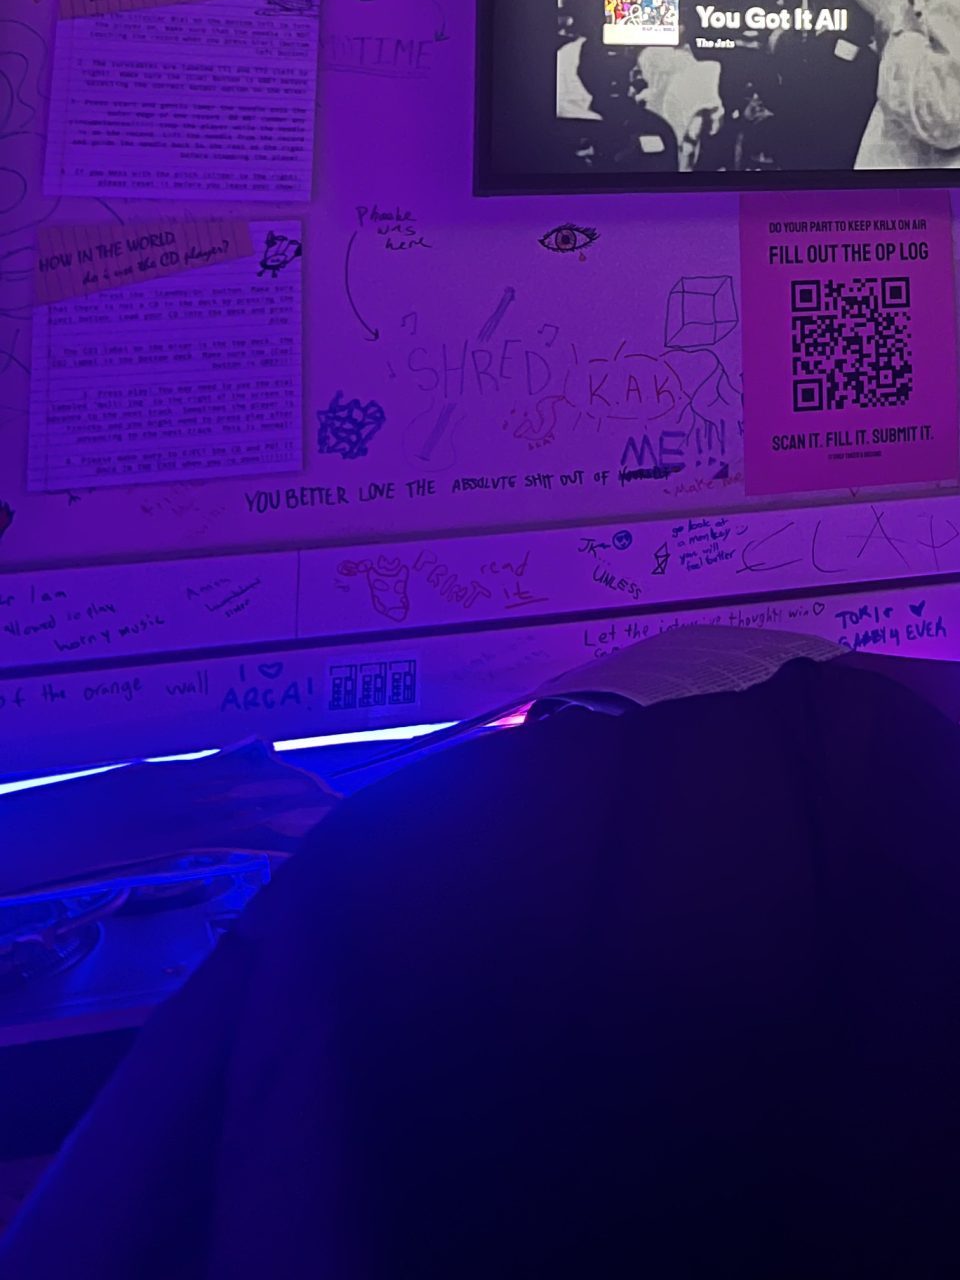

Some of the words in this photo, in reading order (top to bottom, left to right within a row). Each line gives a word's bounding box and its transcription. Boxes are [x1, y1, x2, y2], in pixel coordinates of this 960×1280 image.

[696, 6, 740, 29] You
[745, 7, 791, 31] Got
[794, 8, 812, 31] It
[815, 8, 848, 31] All
[696, 38, 714, 48] The
[769, 222, 782, 233] DO
[784, 221, 808, 233] YOUR
[809, 221, 834, 233] PART
[835, 220, 846, 232] TO
[849, 220, 871, 231] KEEP
[873, 219, 897, 231] KRLX
[898, 219, 910, 230] ON
[912, 219, 927, 230] AIR
[39, 254, 72, 272] HOW
[78, 248, 93, 264] IN
[96, 241, 123, 259] THE
[126, 232, 176, 253] WORLD
[159, 251, 179, 267] CD
[769, 245, 803, 264] FILL
[807, 244, 839, 263] OUT
[841, 243, 872, 262] THE
[875, 242, 896, 261] OP
[900, 241, 929, 261] LOG
[407, 339, 551, 401] SHRED
[772, 433, 806, 451] SCAN
[809, 432, 823, 448] IT.
[826, 431, 853, 448] FILL
[856, 429, 870, 445] IT.
[872, 426, 918, 444] SUBMIT
[920, 425, 934, 441] IT.
[245, 491, 281, 514] YOU
[286, 483, 349, 508] BETTER
[358, 482, 395, 503] LOVE
[405, 479, 436, 498] THE
[524, 473, 553, 488] SHIT
[560, 471, 586, 486] OUT
[594, 470, 611, 486] OF
[593, 565, 643, 600] UNLESS
[118, 614, 165, 637] music
[584, 624, 616, 646] Let
[624, 622, 650, 638] the
[906, 615, 947, 640] EVER
[83, 677, 142, 702] orange
[165, 669, 208, 696] wall
